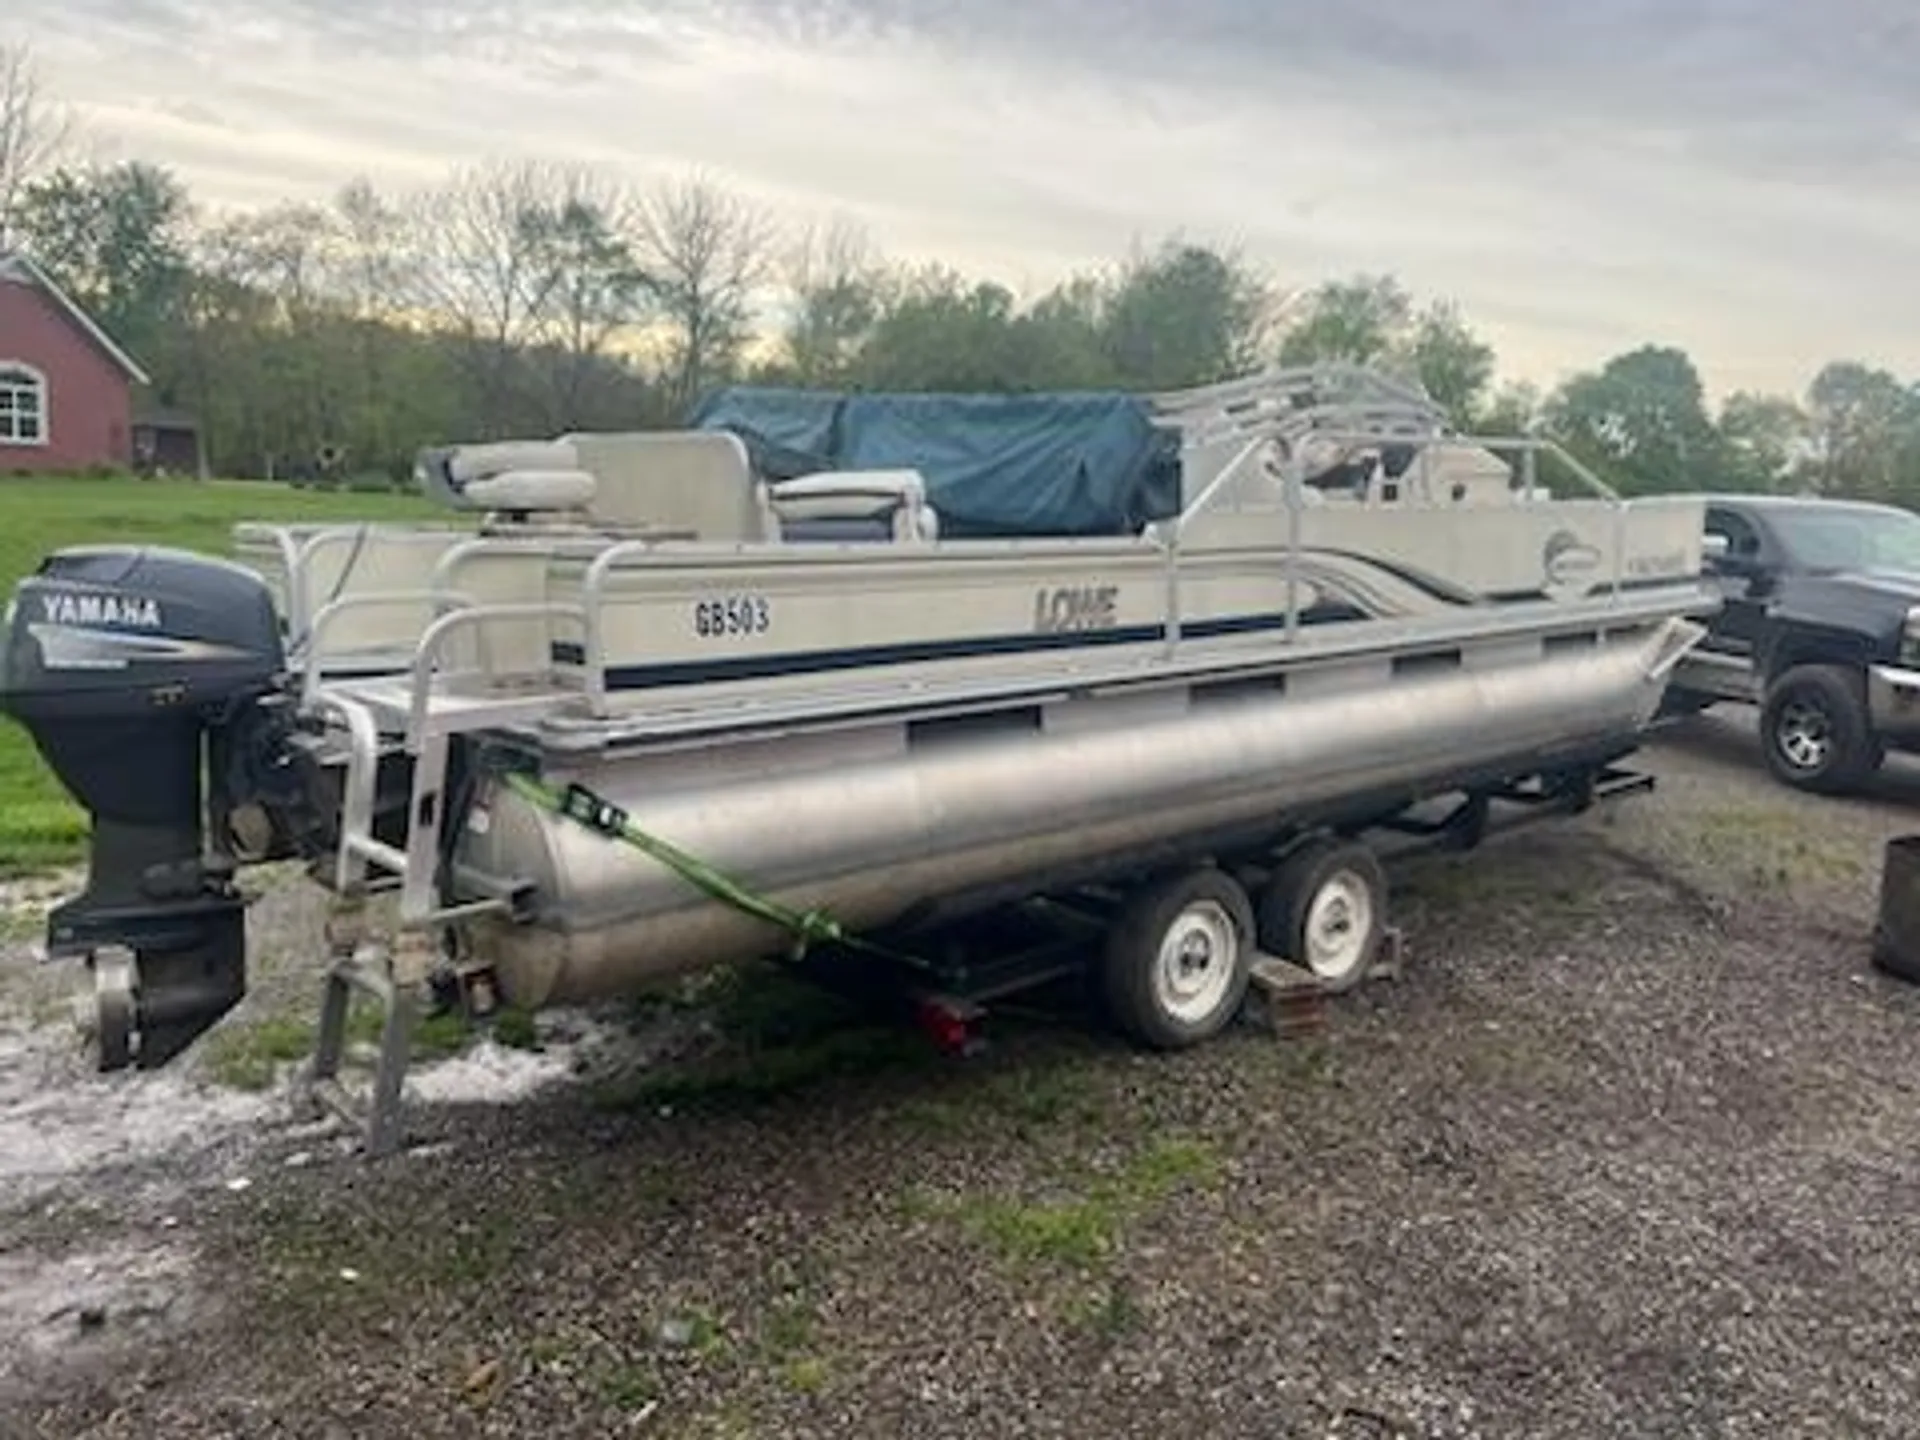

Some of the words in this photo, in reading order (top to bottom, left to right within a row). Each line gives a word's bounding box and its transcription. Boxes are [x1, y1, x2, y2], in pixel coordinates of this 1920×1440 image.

[44, 595, 161, 626] YAMAHA
[695, 596, 769, 636] GB503
[1034, 586, 1118, 631] LOWE
